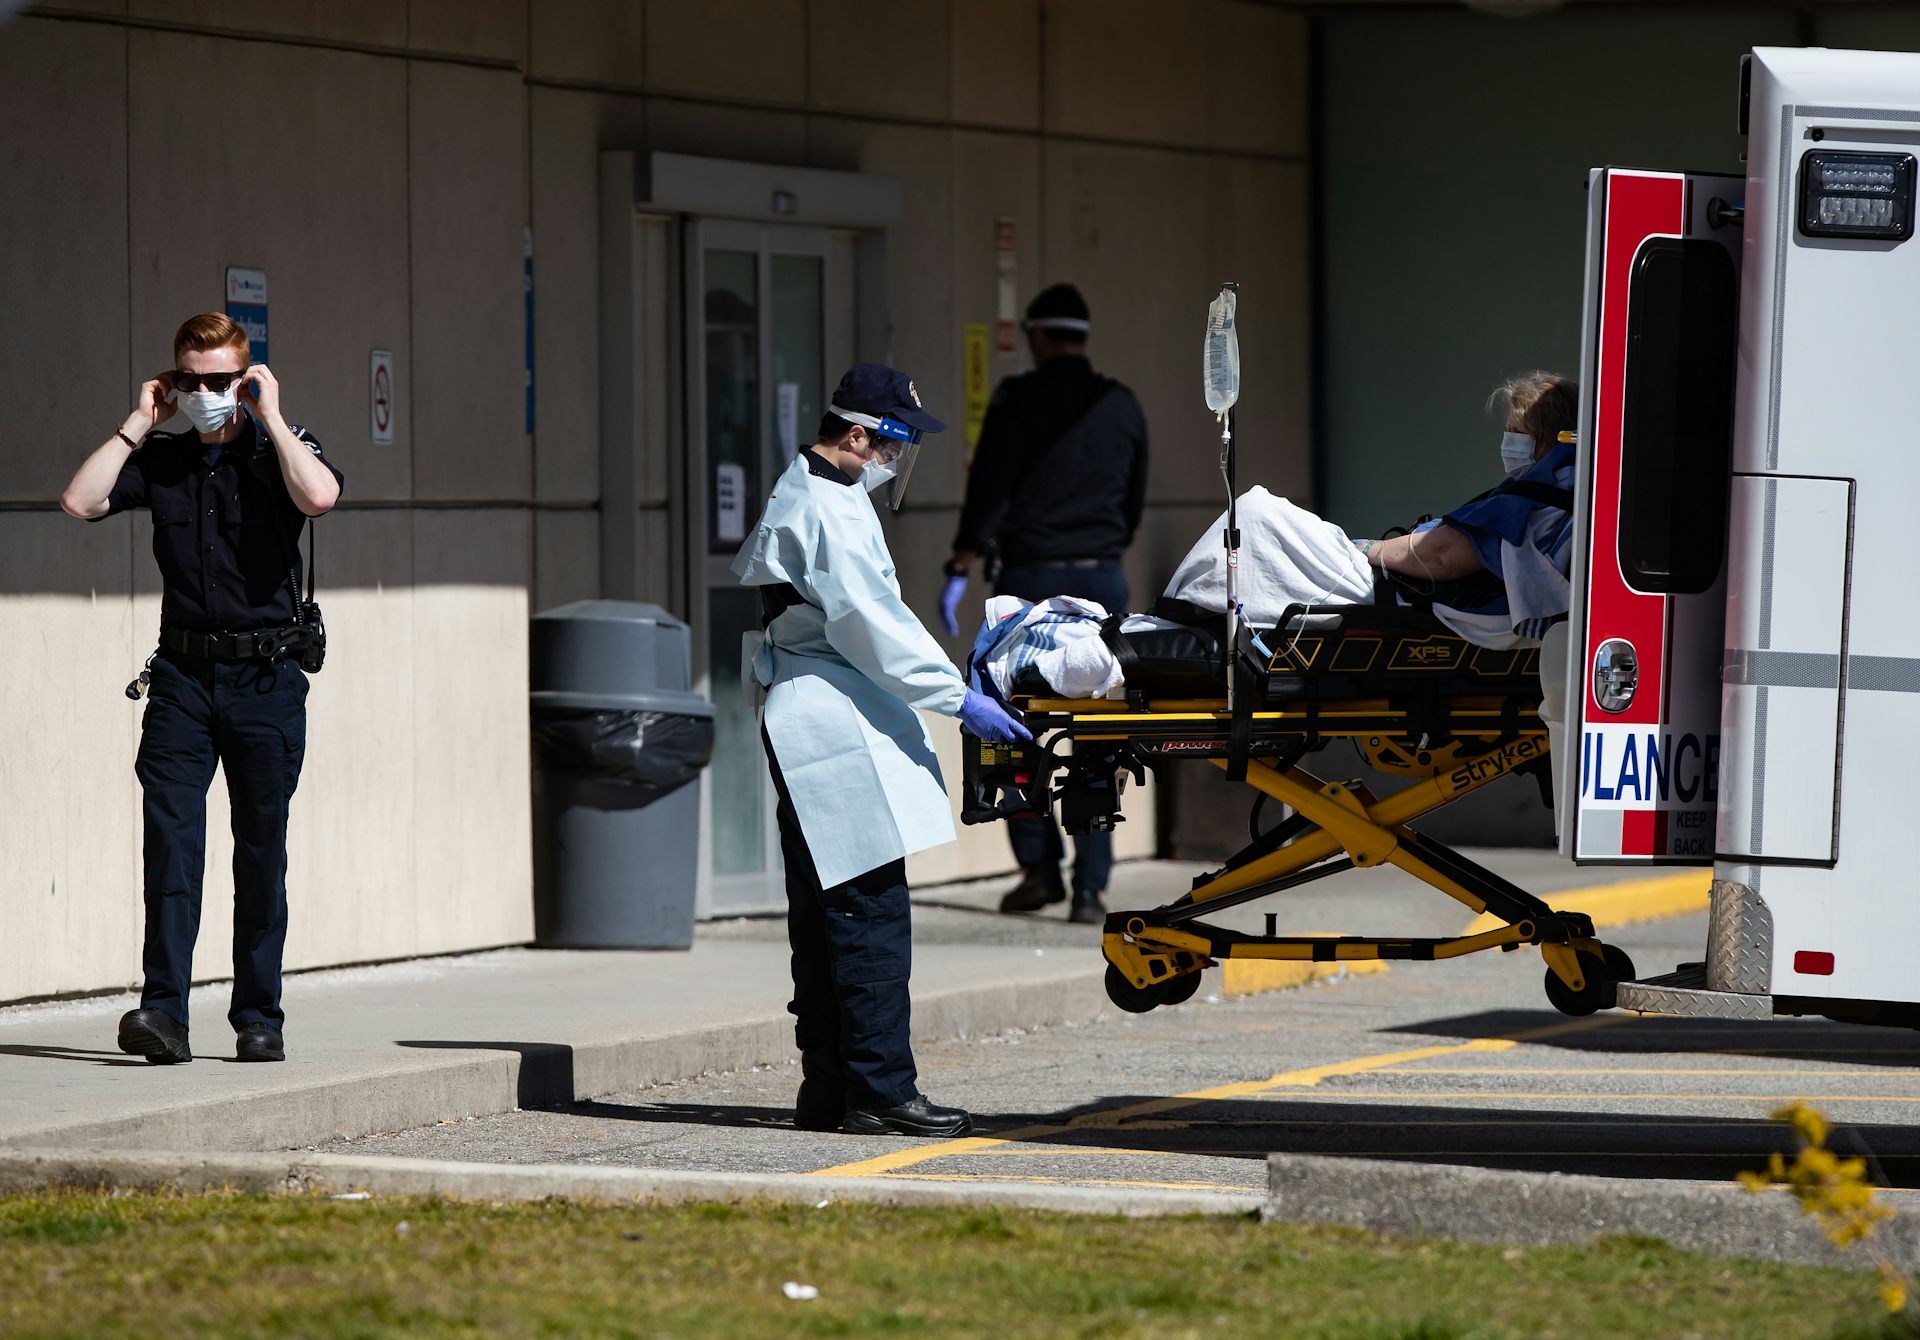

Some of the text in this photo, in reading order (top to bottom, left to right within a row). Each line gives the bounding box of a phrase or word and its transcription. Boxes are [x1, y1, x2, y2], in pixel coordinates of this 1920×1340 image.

[1408, 646, 1450, 660] XPS
[1451, 734, 1546, 791] stryker
[1676, 811, 1706, 828] KEEP
[1674, 838, 1706, 855] BACK
